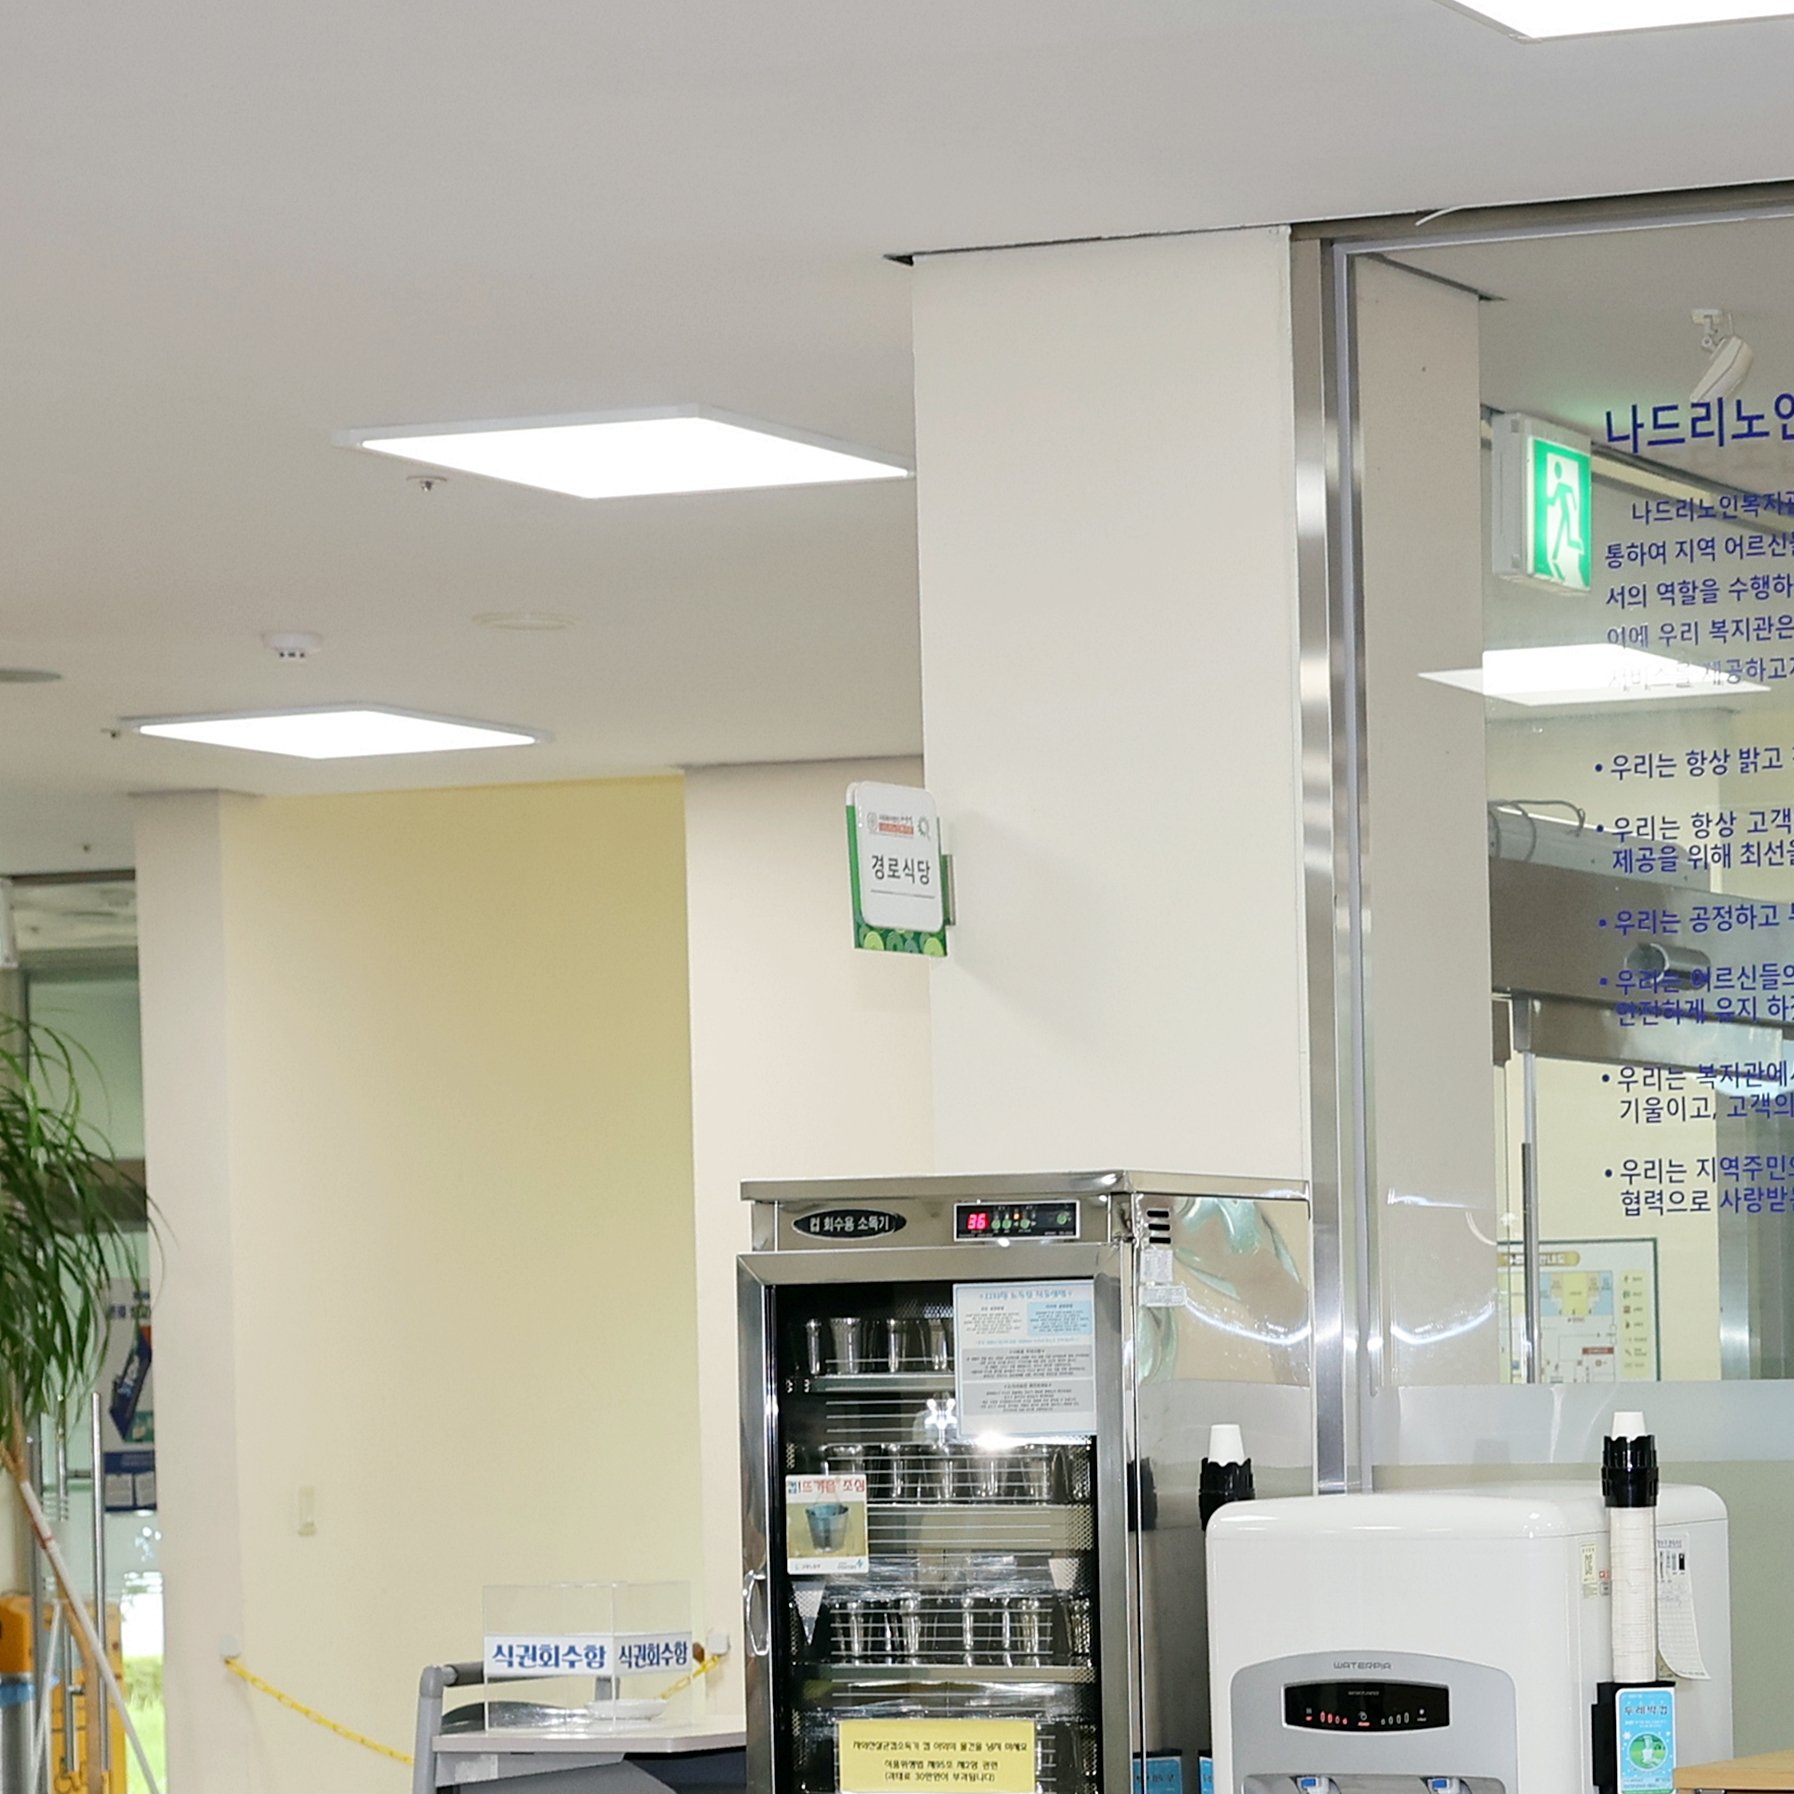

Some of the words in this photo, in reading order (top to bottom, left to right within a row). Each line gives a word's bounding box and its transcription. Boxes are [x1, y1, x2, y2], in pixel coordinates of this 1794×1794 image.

[1603, 538, 1669, 569] 통하여
[1673, 535, 1716, 564] 지역
[1604, 578, 1650, 609] 서의
[1655, 574, 1722, 607] 역할을
[1610, 748, 1678, 783] 우리는
[1685, 745, 1731, 778] 항상
[1737, 742, 1784, 775] 밝고
[872, 854, 930, 885] 경로식당
[1611, 844, 1679, 875] 제공을
[1686, 841, 1732, 872] 위해
[1614, 906, 1682, 938] 우리는
[1688, 901, 1780, 934] 공정하고
[1614, 965, 1681, 998] 우리는
[1618, 1092, 1718, 1125] 기울이고,
[1618, 1154, 1689, 1186] 우리는
[1619, 1187, 1712, 1218] 협력으로
[824, 1217, 855, 1232] 회수용
[858, 1216, 889, 1232] 소독기
[967, 1213, 988, 1230] 36
[492, 1644, 606, 1669] 식권회수함
[619, 1641, 688, 1669] 식권회수함
[1334, 1662, 1392, 1670] WATERPIA
